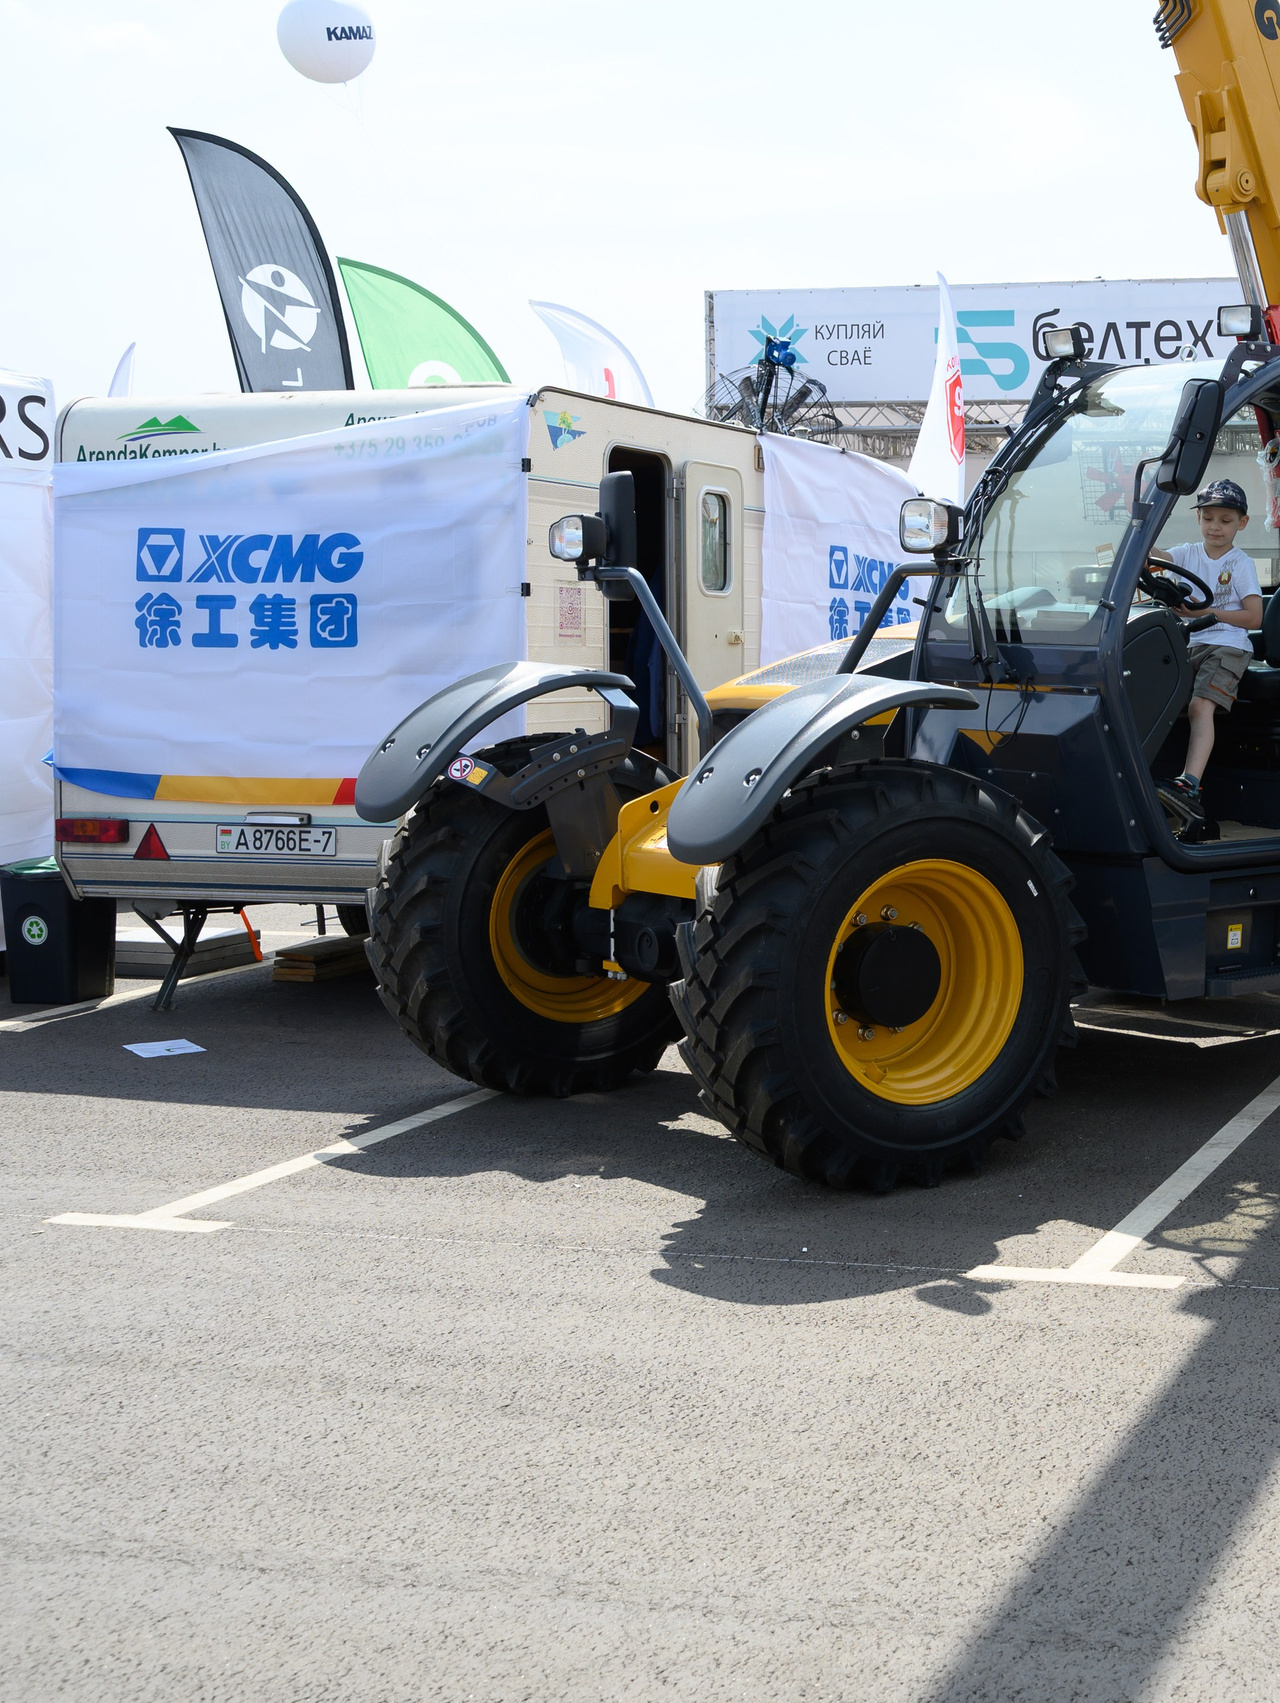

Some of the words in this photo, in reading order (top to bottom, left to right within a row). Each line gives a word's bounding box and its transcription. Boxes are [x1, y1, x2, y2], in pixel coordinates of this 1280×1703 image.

[326, 26, 373, 41] KAMAZ
[814, 320, 885, 340] КУПЛЯЙ
[827, 348, 872, 366] СВАЁ
[187, 532, 364, 583] XCMG
[134, 592, 359, 650] 徐工集团
[220, 841, 231, 850] BY
